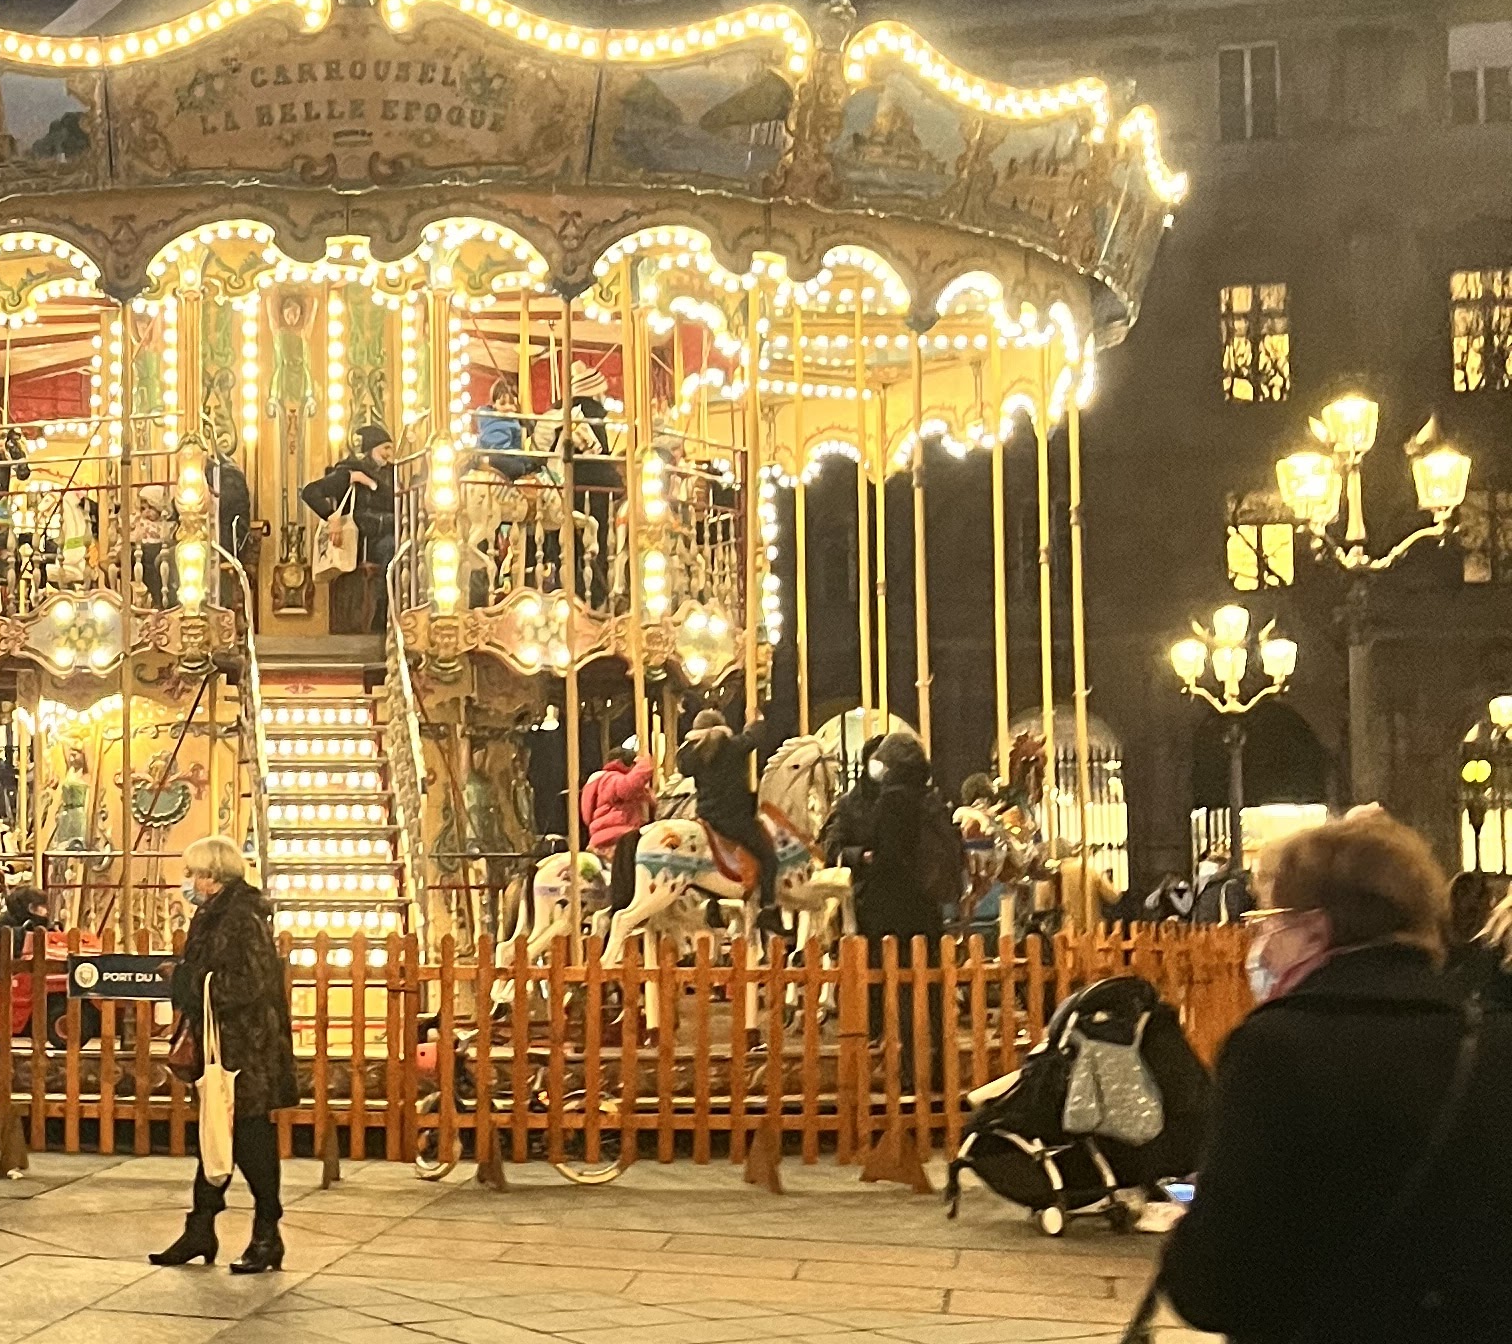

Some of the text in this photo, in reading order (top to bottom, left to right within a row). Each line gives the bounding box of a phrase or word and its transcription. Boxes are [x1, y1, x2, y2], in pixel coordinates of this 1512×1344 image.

[250, 59, 456, 88] CARROUSEL
[200, 99, 506, 136] LA BELLE EPOQUE
[102, 972, 133, 982] PORT
[135, 972, 153, 982] DU
